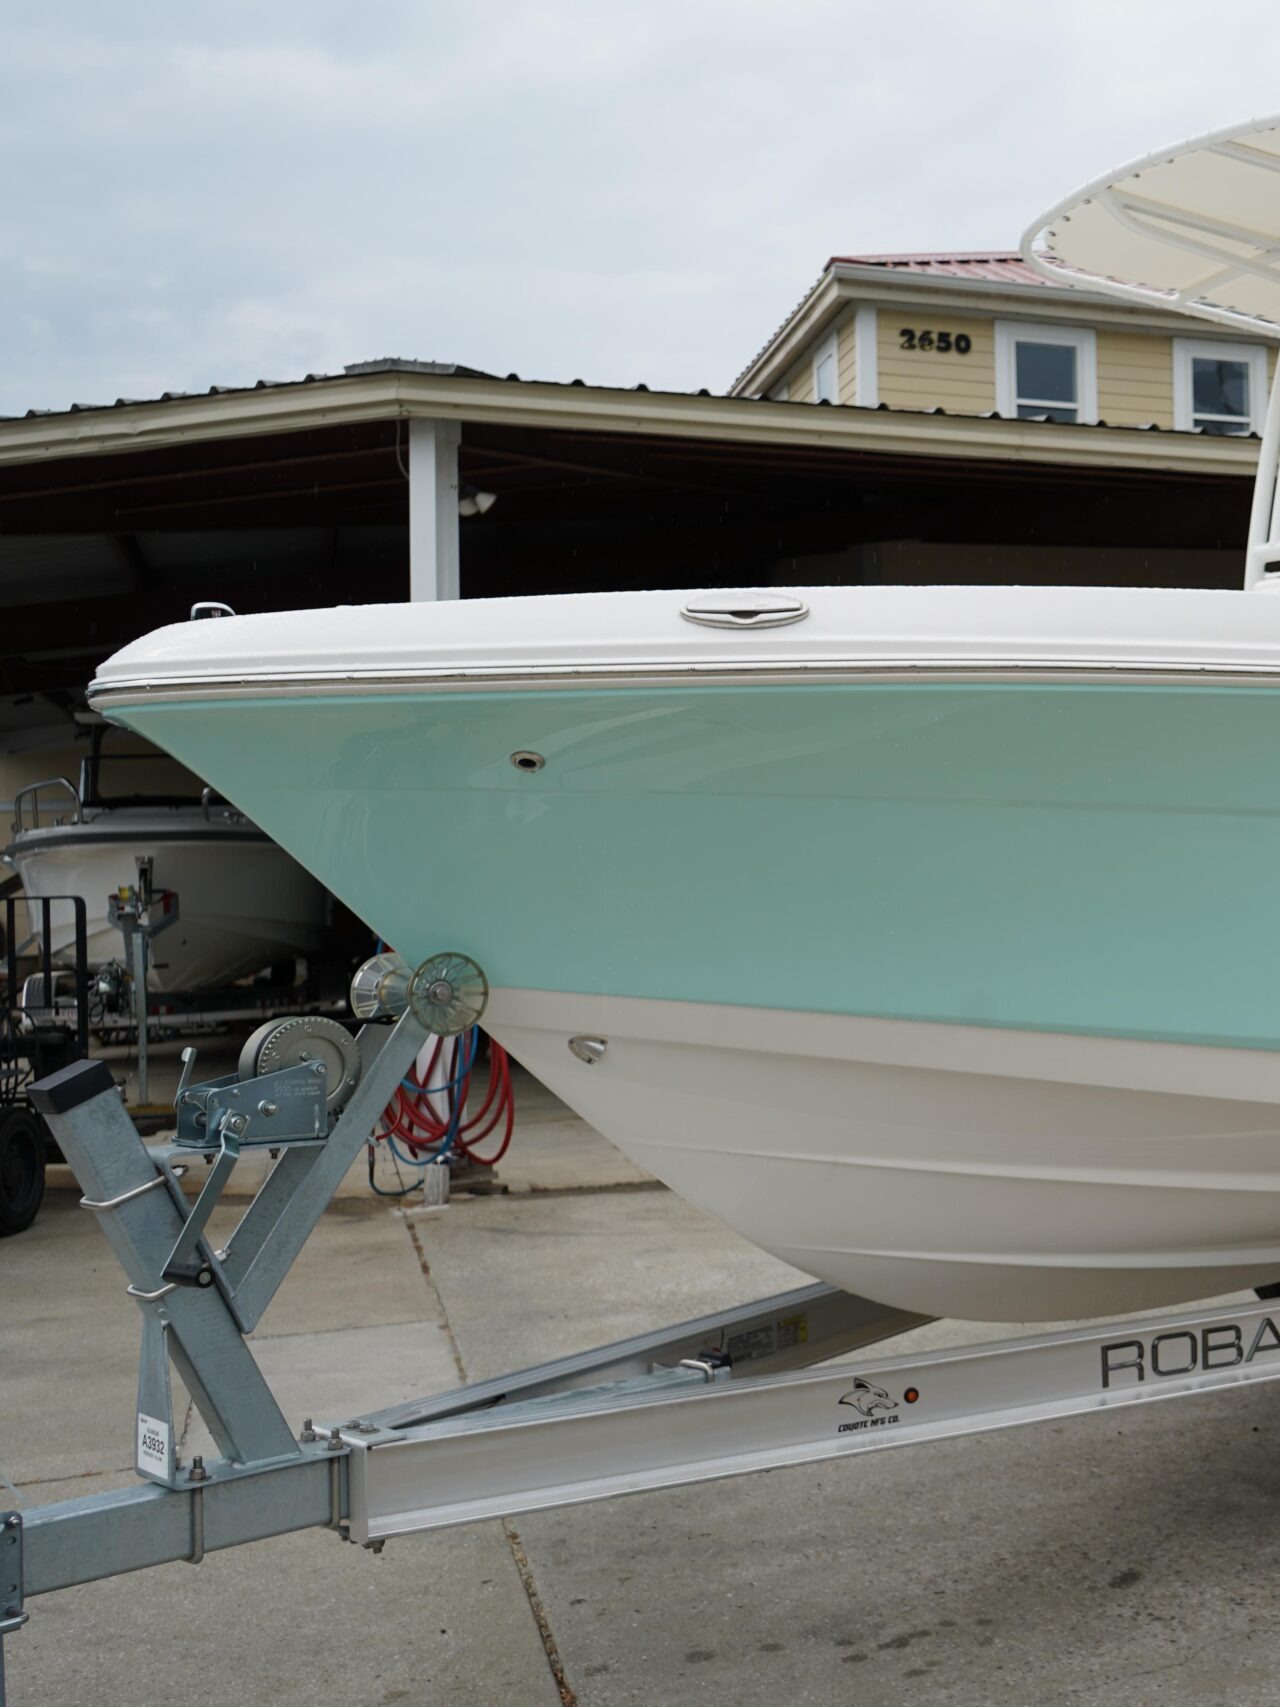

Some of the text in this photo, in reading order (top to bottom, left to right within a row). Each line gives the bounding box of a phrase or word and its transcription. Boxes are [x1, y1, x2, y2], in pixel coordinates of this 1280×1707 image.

[899, 328, 972, 355] 2650
[838, 1420, 869, 1433] COYOTE
[870, 1416, 887, 1427] MFG
[142, 1433, 165, 1456] A3932
